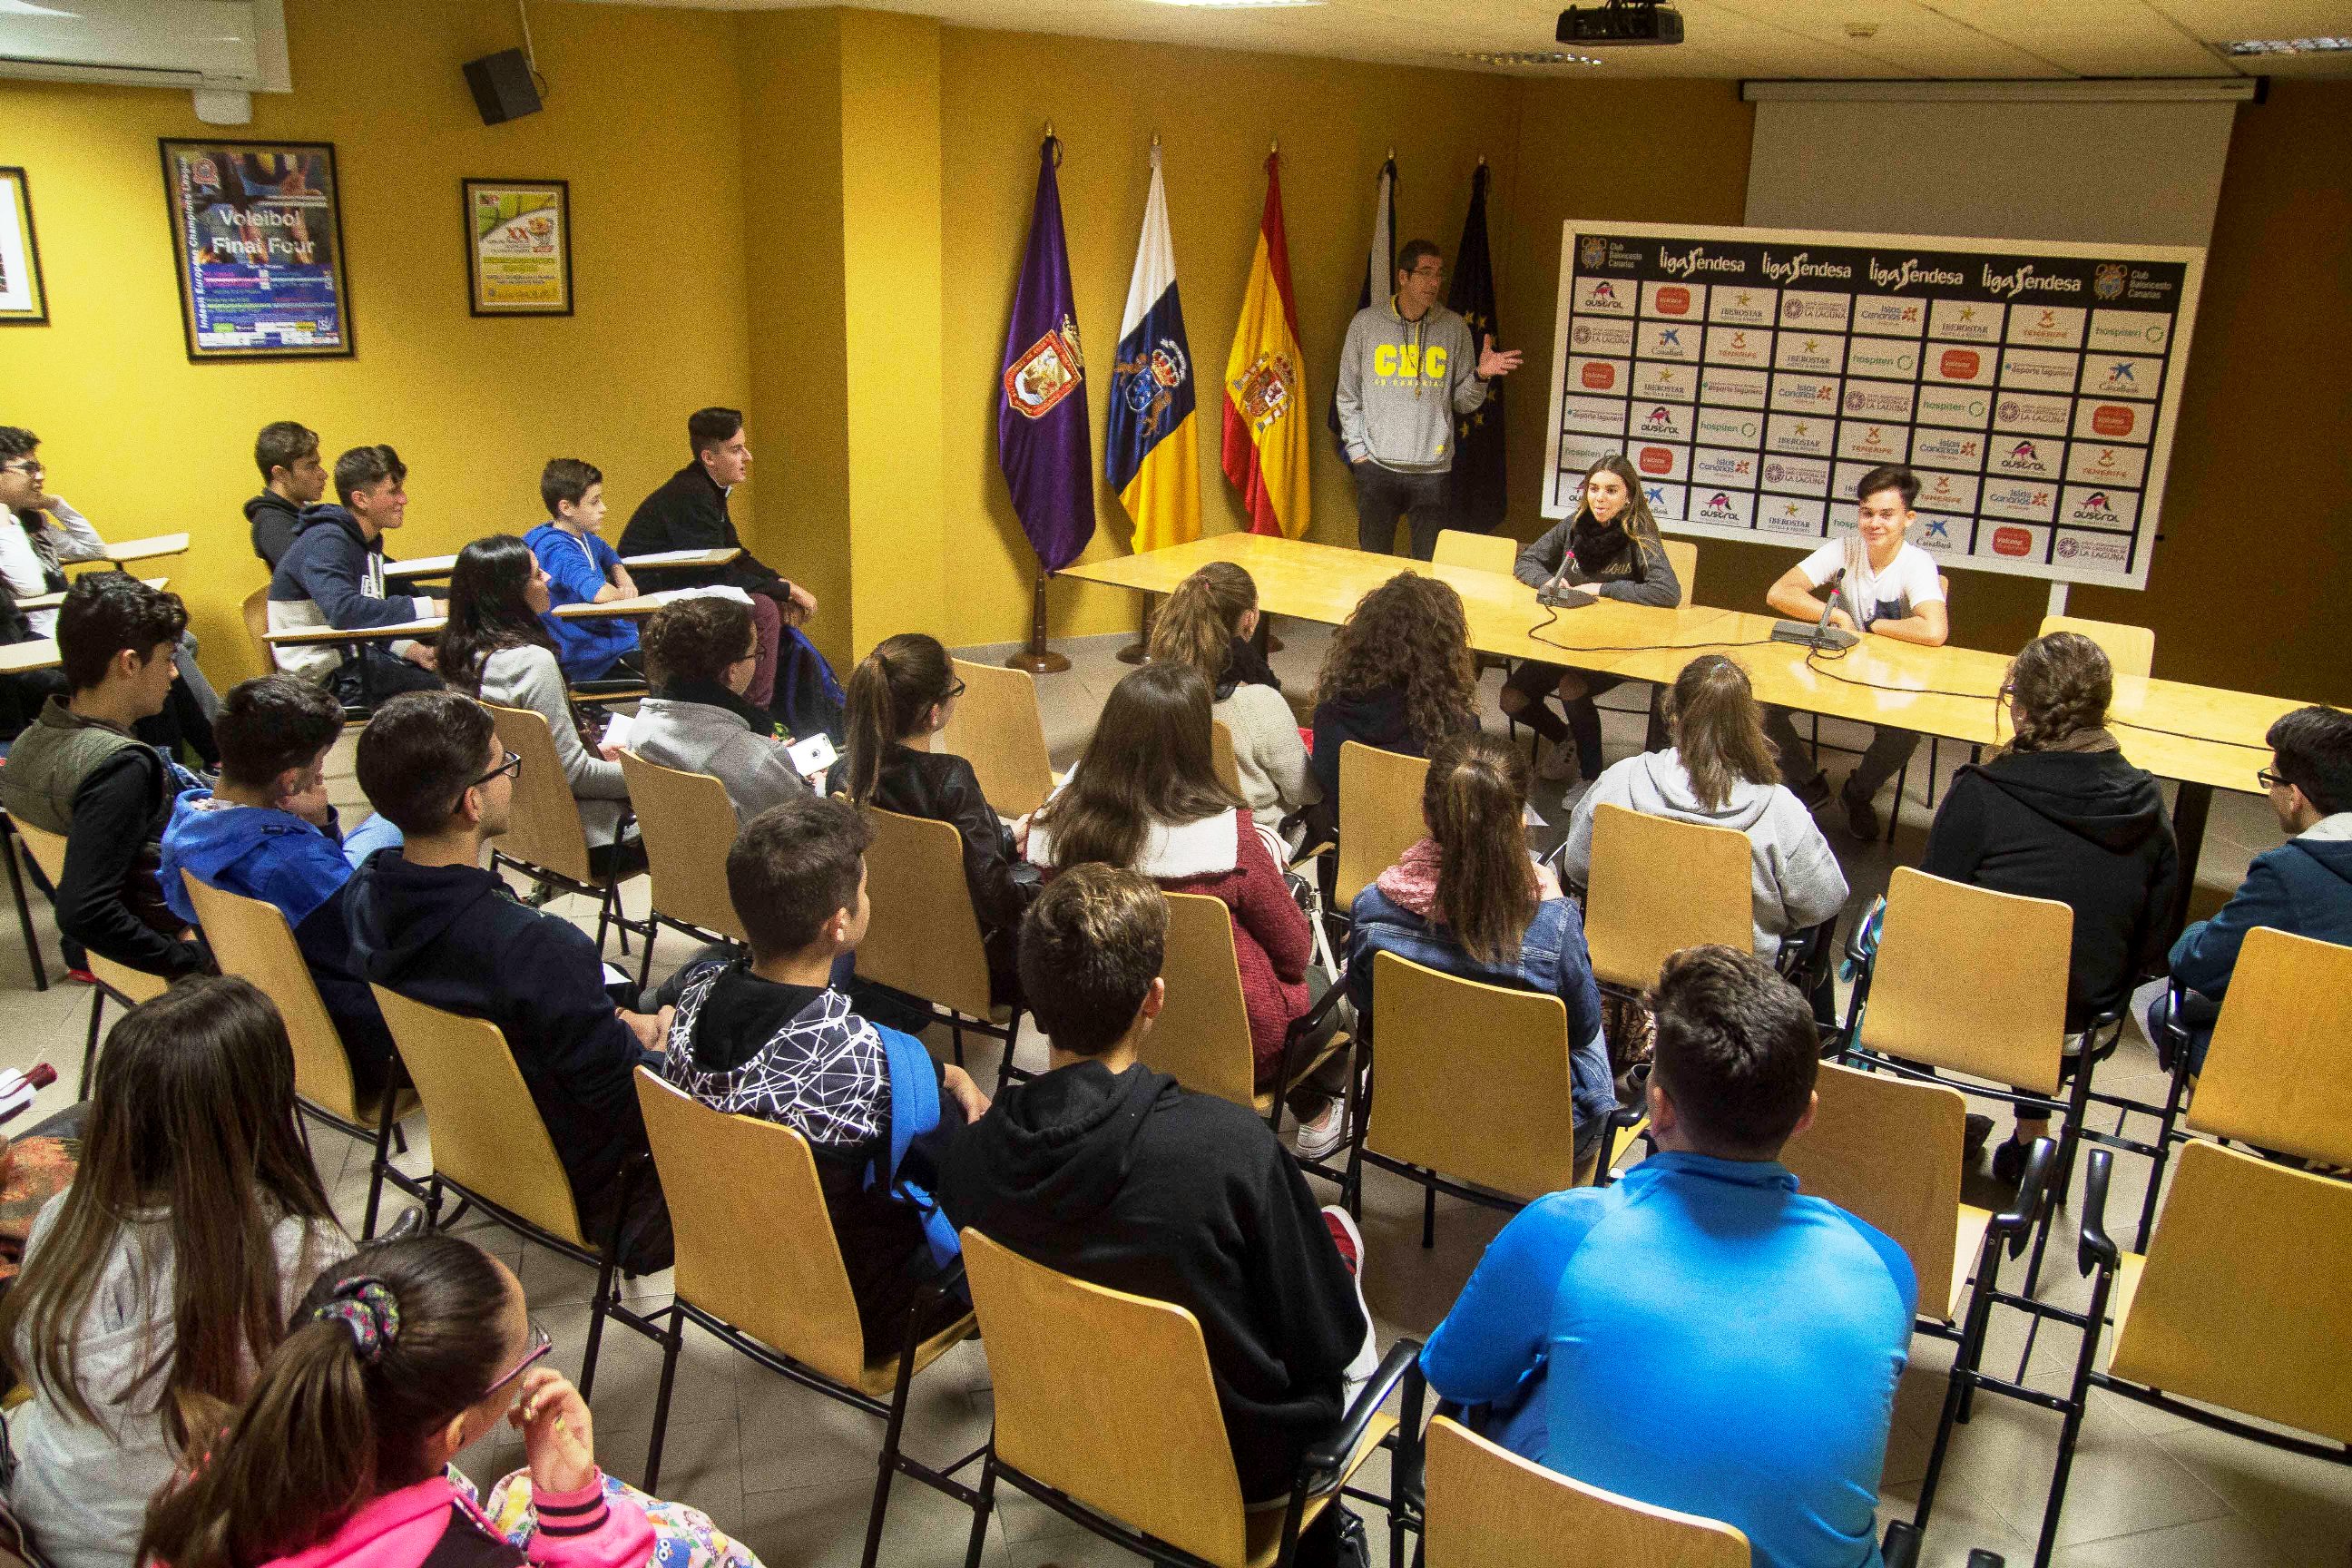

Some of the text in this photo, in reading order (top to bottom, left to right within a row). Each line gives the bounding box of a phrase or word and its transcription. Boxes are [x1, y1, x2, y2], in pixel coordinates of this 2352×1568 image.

[220, 210, 299, 227] Voleibol
[212, 236, 316, 255] Final Four
[2001, 459, 2047, 472] austral
[1700, 510, 1740, 521] austral
[2073, 510, 2120, 523] austral
[1769, 518, 1810, 528] IBEROSTAR
